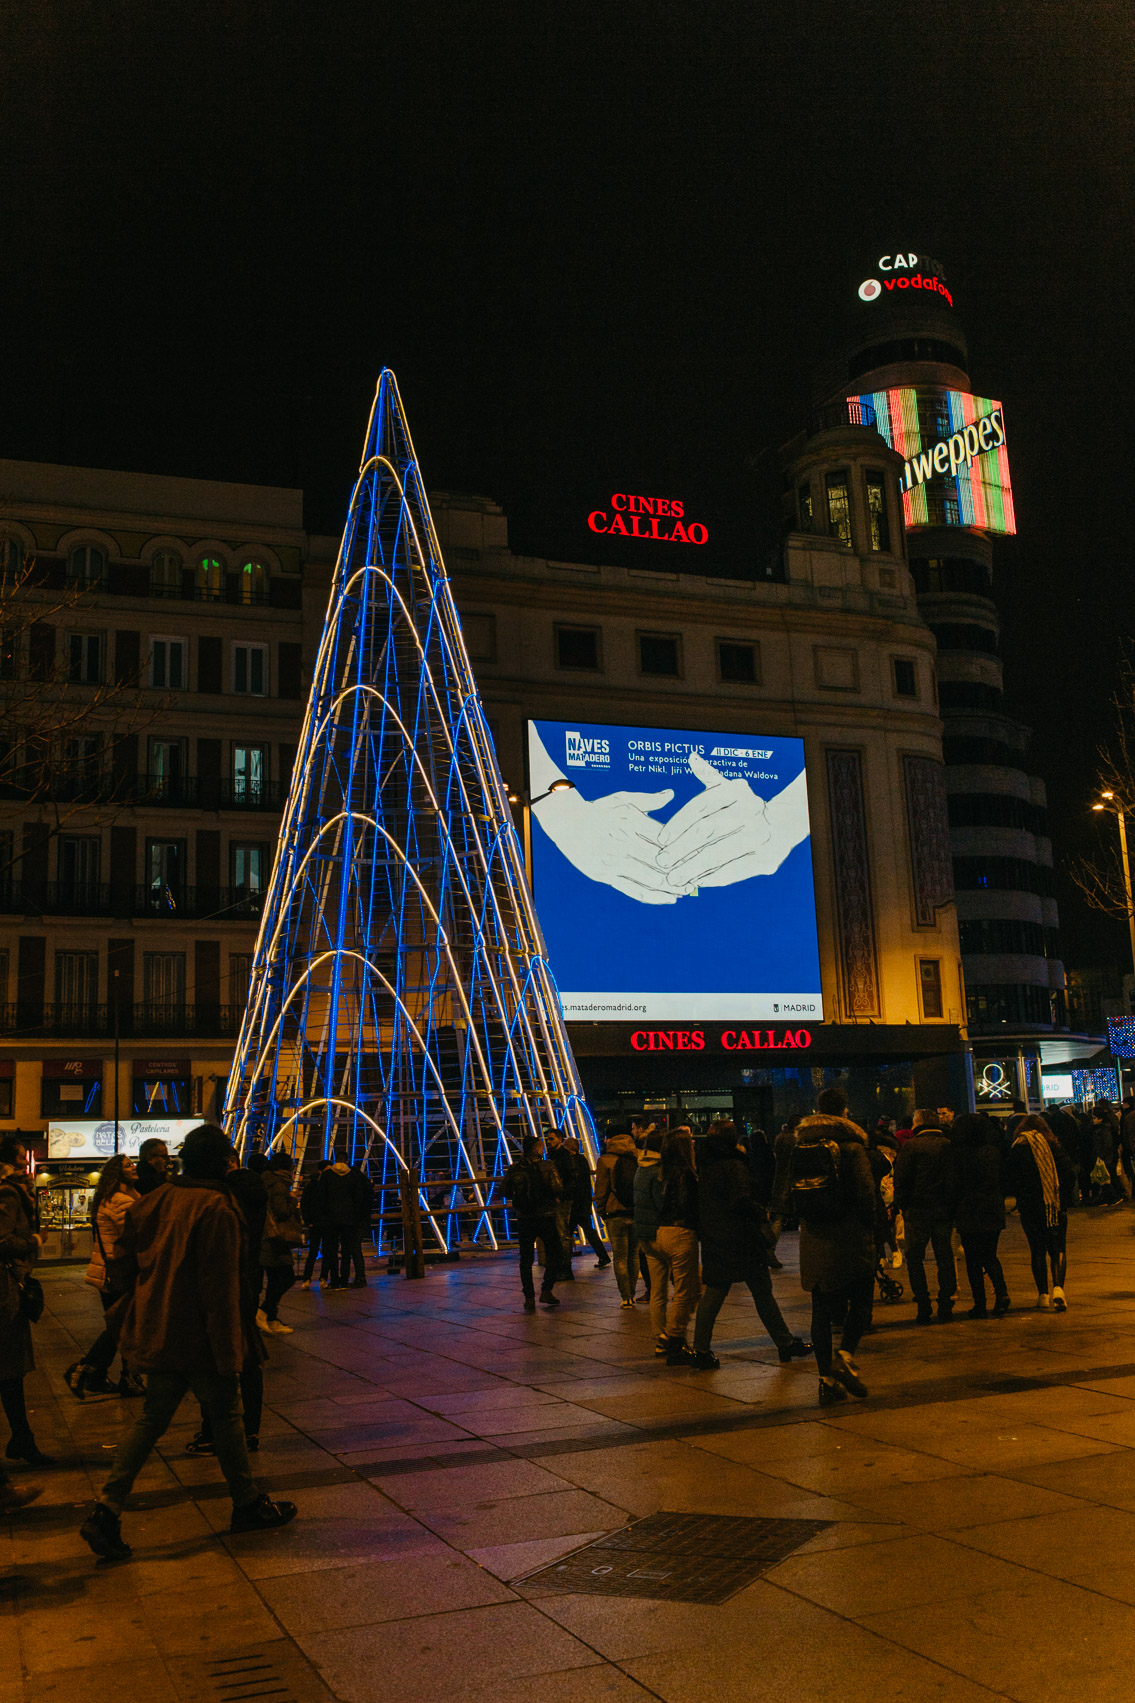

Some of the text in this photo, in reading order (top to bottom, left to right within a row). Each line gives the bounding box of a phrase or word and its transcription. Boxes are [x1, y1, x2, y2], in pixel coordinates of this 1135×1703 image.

[611, 493, 685, 518] CINES
[588, 511, 709, 545] CALLAO
[568, 738, 610, 753] NAVES
[628, 740, 705, 755] ORBIS PICTUS
[724, 748, 738, 756] DIC
[752, 750, 768, 758] ENE
[568, 752, 611, 763] MATADERO
[629, 753, 645, 762] Una
[649, 754, 690, 765] exposició
[738, 759, 748, 767] de
[629, 764, 646, 772] Petr
[744, 770, 779, 780] Waldova
[783, 1004, 815, 1012] MADRID
[631, 1029, 812, 1051] CINES CALLAO
